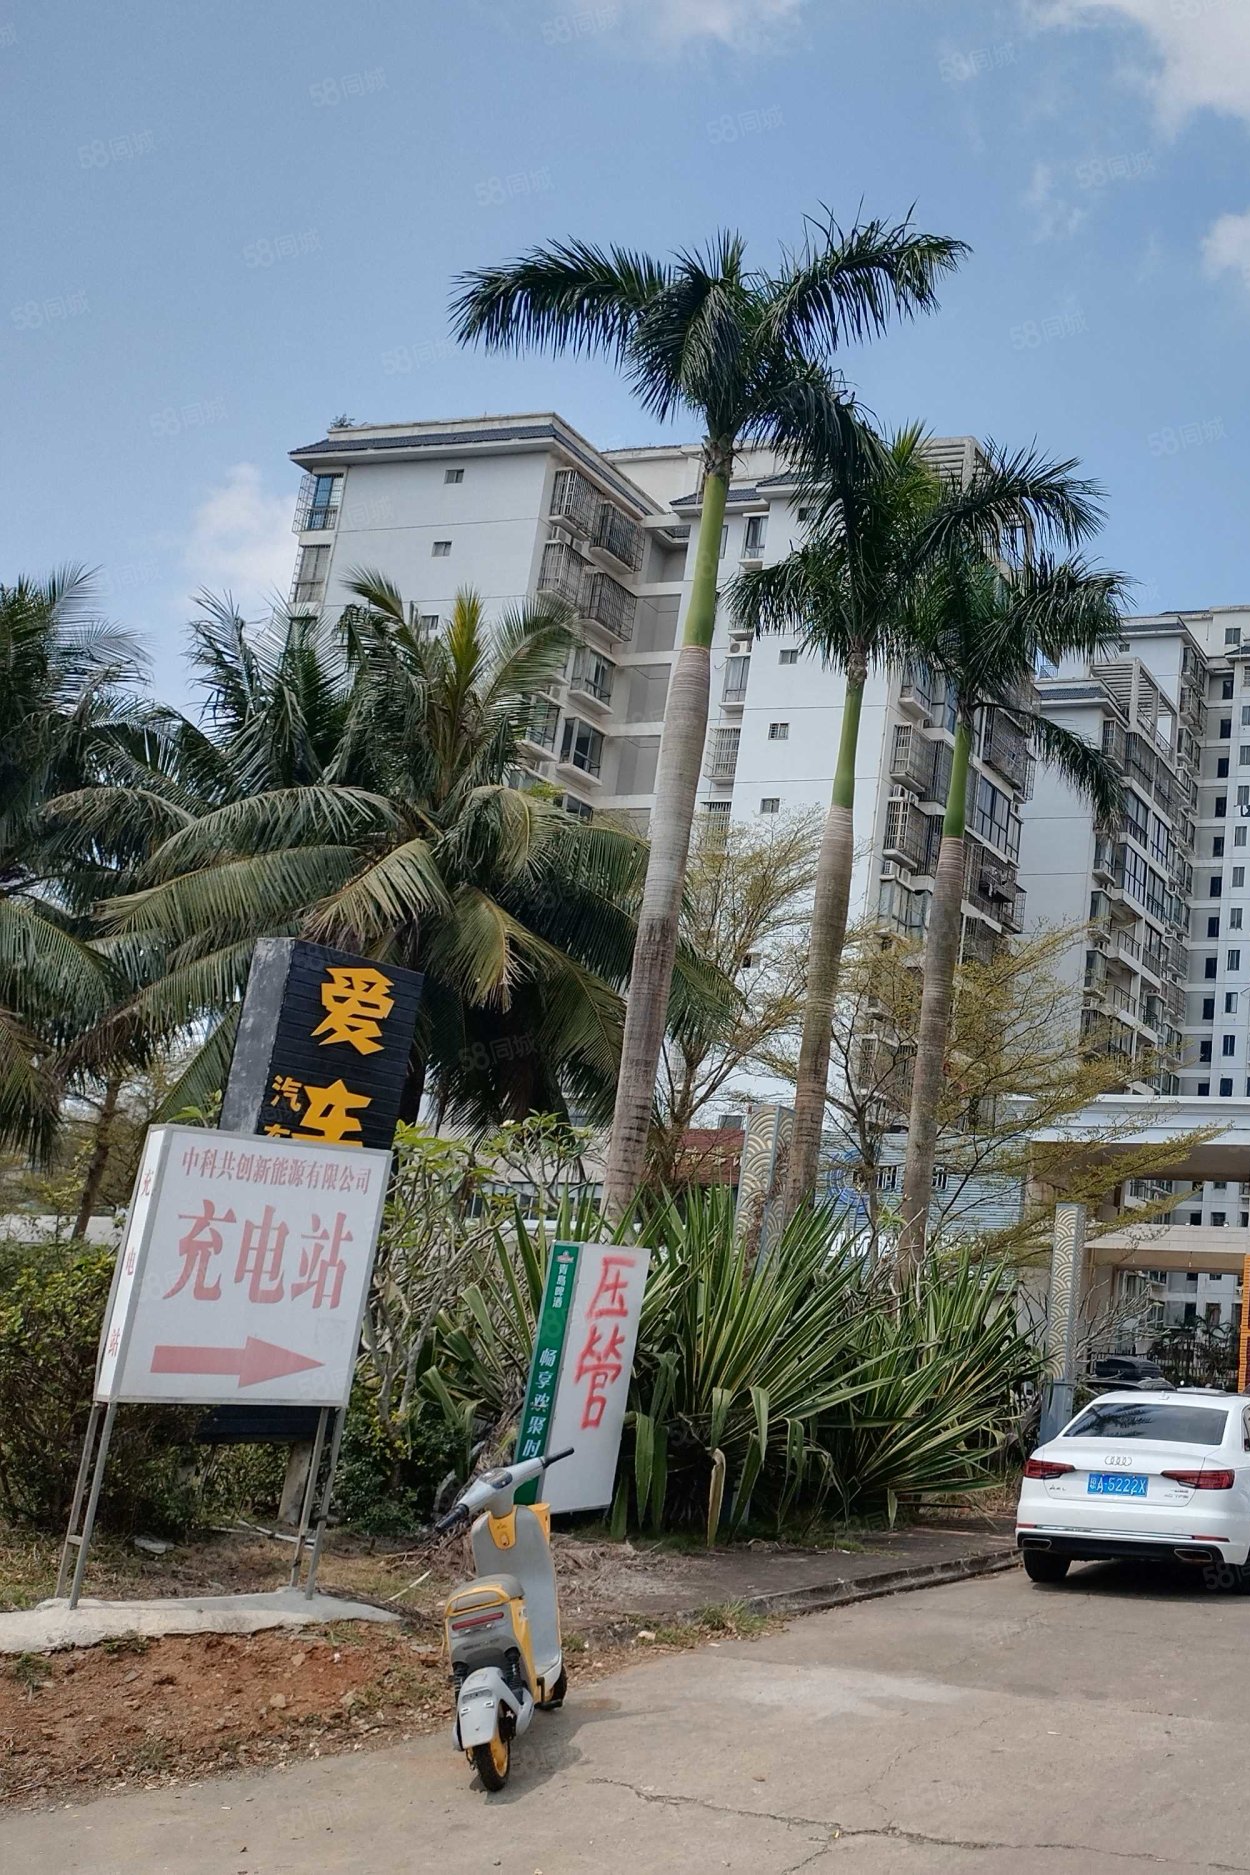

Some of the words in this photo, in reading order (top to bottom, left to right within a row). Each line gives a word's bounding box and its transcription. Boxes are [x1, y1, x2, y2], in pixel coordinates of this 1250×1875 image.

[182, 1146, 371, 1194] 中科共创新能源有限公司
[162, 1199, 354, 1309] 充电站
